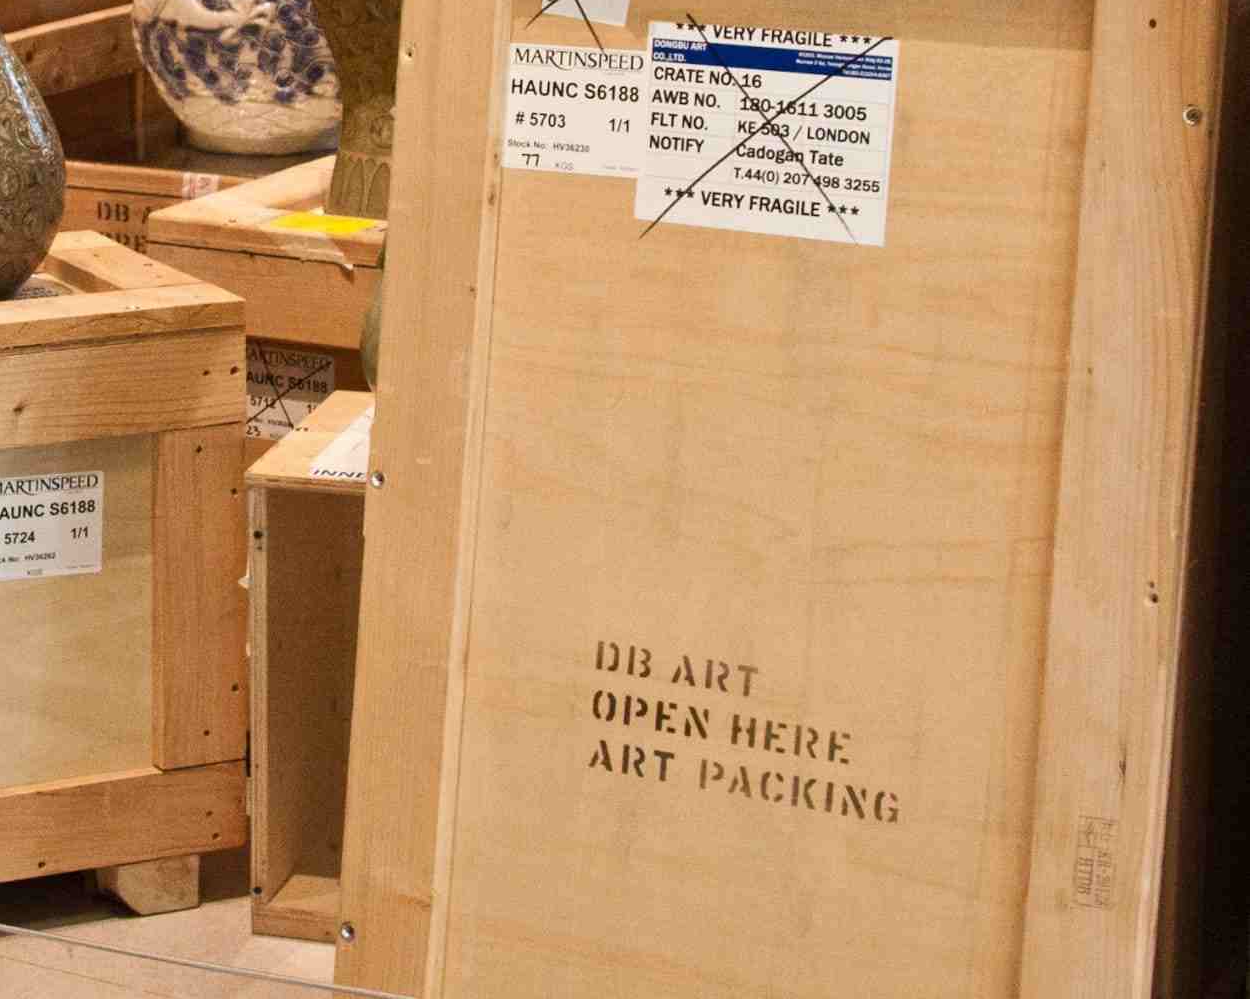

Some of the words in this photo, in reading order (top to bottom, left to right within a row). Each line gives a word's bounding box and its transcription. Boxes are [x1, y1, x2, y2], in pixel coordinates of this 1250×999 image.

[713, 24, 755, 42] VERY
[762, 28, 834, 47] FRAGILE
[514, 47, 644, 72] MARTINSPEED
[511, 78, 579, 99] HAUNC
[584, 83, 639, 102] S6188
[653, 66, 707, 84] CRATE
[741, 74, 763, 89] 16
[651, 89, 690, 105] AWB
[693, 92, 721, 108] NO.
[740, 97, 818, 117] 180-1611
[822, 104, 868, 121] 3005
[515, 111, 525, 124] #
[529, 111, 567, 129] 5703
[608, 118, 631, 133] 1/1
[650, 111, 680, 128] FLT
[681, 115, 709, 131] NO.
[806, 126, 871, 145] LONDON
[521, 152, 541, 168] 77
[649, 134, 705, 153] NOTIFY
[735, 143, 804, 164] Cadogan
[810, 150, 845, 167] Tate
[733, 166, 780, 185] T.44(0)
[783, 172, 809, 186] 207
[843, 178, 881, 193] 3255
[700, 190, 745, 210] VERY
[749, 195, 822, 217] FRAGILE
[246, 371, 284, 388] AUNC
[49, 499, 96, 516] S6188
[4, 531, 36, 545] 5724
[70, 526, 89, 539] 1/1
[595, 640, 652, 679] DB
[671, 654, 759, 698] ART
[592, 689, 710, 740] OPEN
[730, 713, 852, 766] HERE
[588, 739, 676, 783] ART
[699, 758, 900, 824] PACKING
